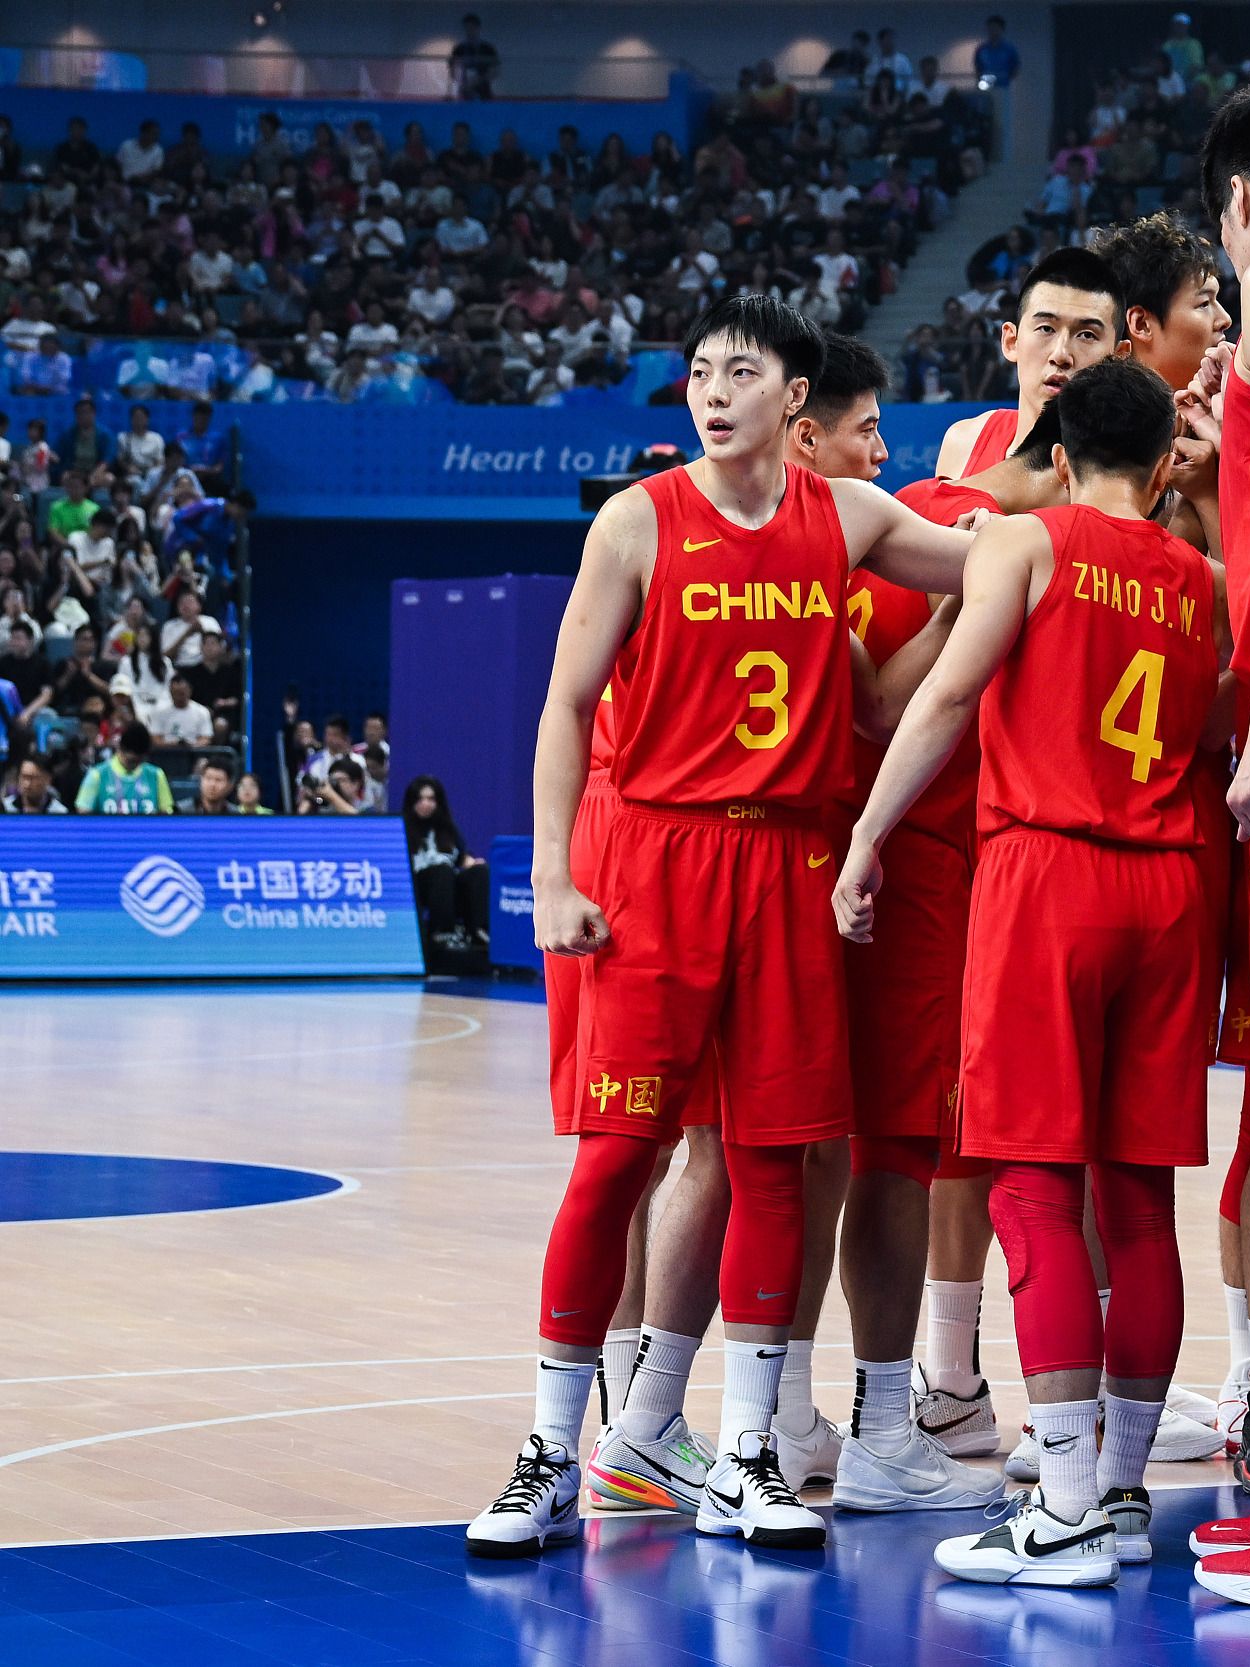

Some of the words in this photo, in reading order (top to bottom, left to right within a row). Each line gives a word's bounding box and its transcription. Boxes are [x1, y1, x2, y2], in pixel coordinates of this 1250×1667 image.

[443, 443, 546, 473] Heart
[558, 446, 594, 473] to
[682, 581, 834, 621] CHINA
[1072, 561, 1142, 618] ZHAO
[735, 651, 789, 749] 3
[1100, 649, 1165, 784] 4
[727, 805, 766, 820] CHN
[217, 859, 383, 900] 中国移动
[2, 911, 59, 937] AIR
[222, 902, 299, 929] China
[302, 902, 387, 929] Mobile
[589, 1072, 662, 1116] 中国
